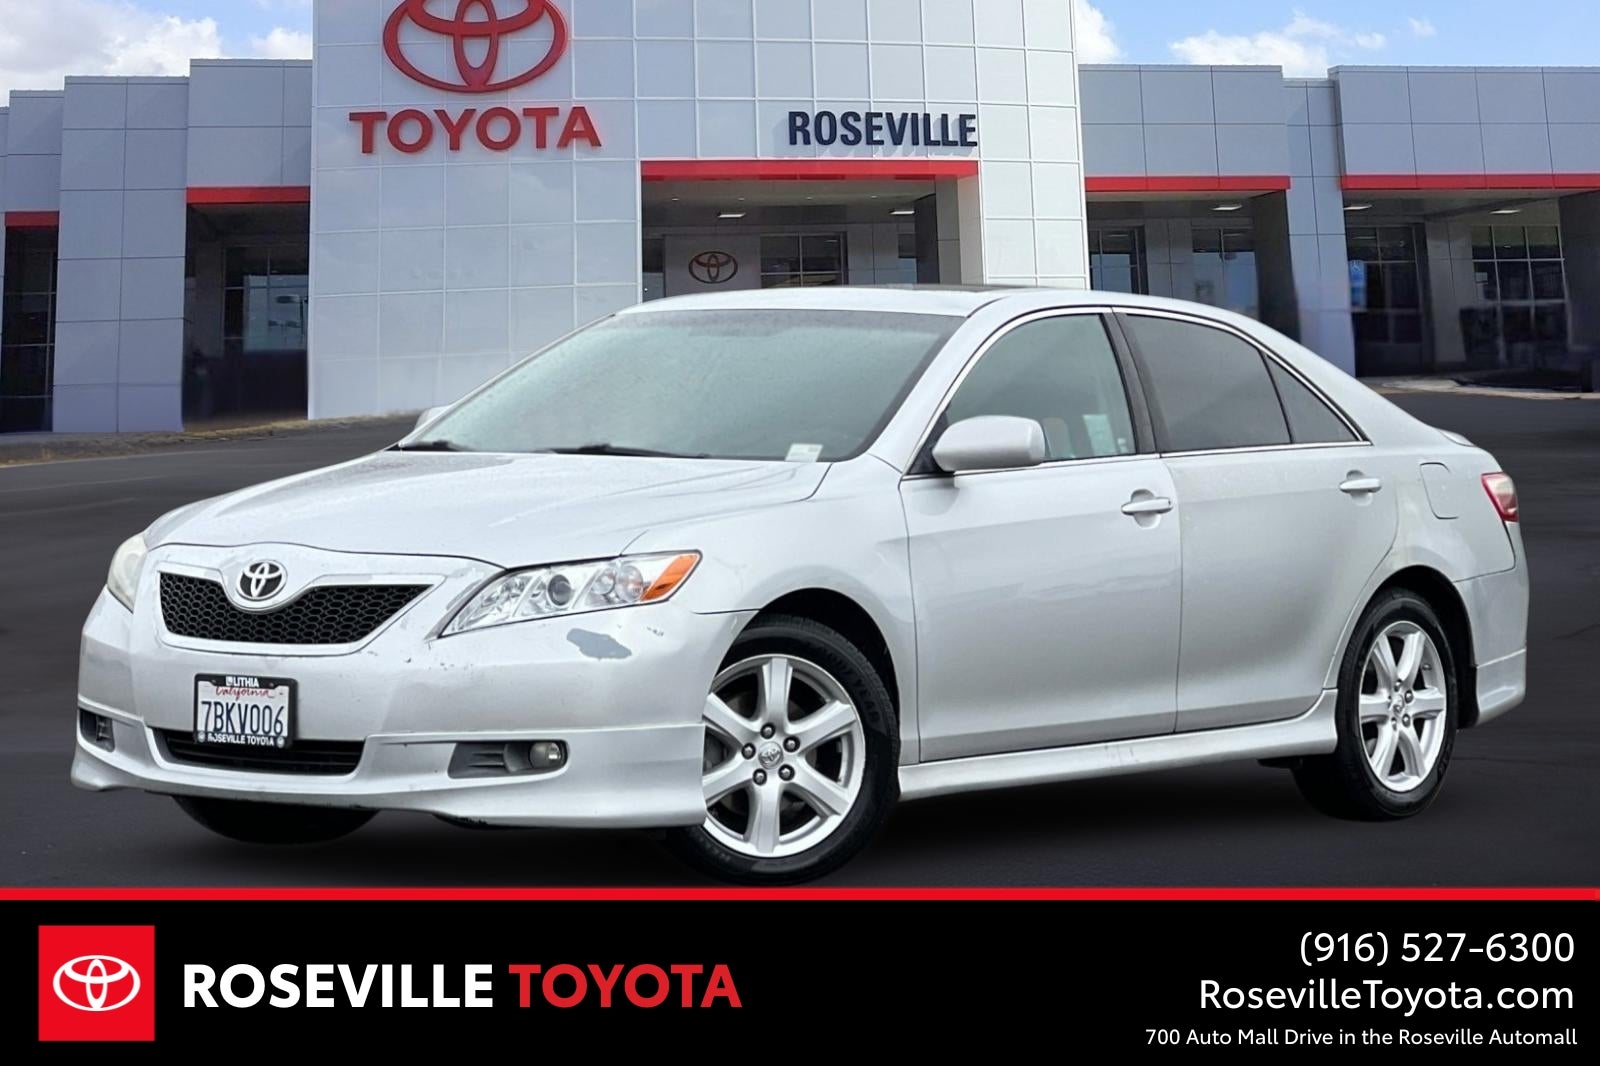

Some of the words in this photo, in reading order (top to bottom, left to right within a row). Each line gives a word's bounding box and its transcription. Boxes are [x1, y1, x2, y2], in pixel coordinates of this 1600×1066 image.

[349, 106, 602, 154] TOYOTA
[788, 111, 979, 147] ROSEVILLE
[215, 686, 275, 701] California
[233, 676, 260, 688] LITHIA
[200, 700, 284, 736] 7BKV006
[206, 733, 246, 745] ROSEVILLE
[246, 735, 275, 747] TOYOTA
